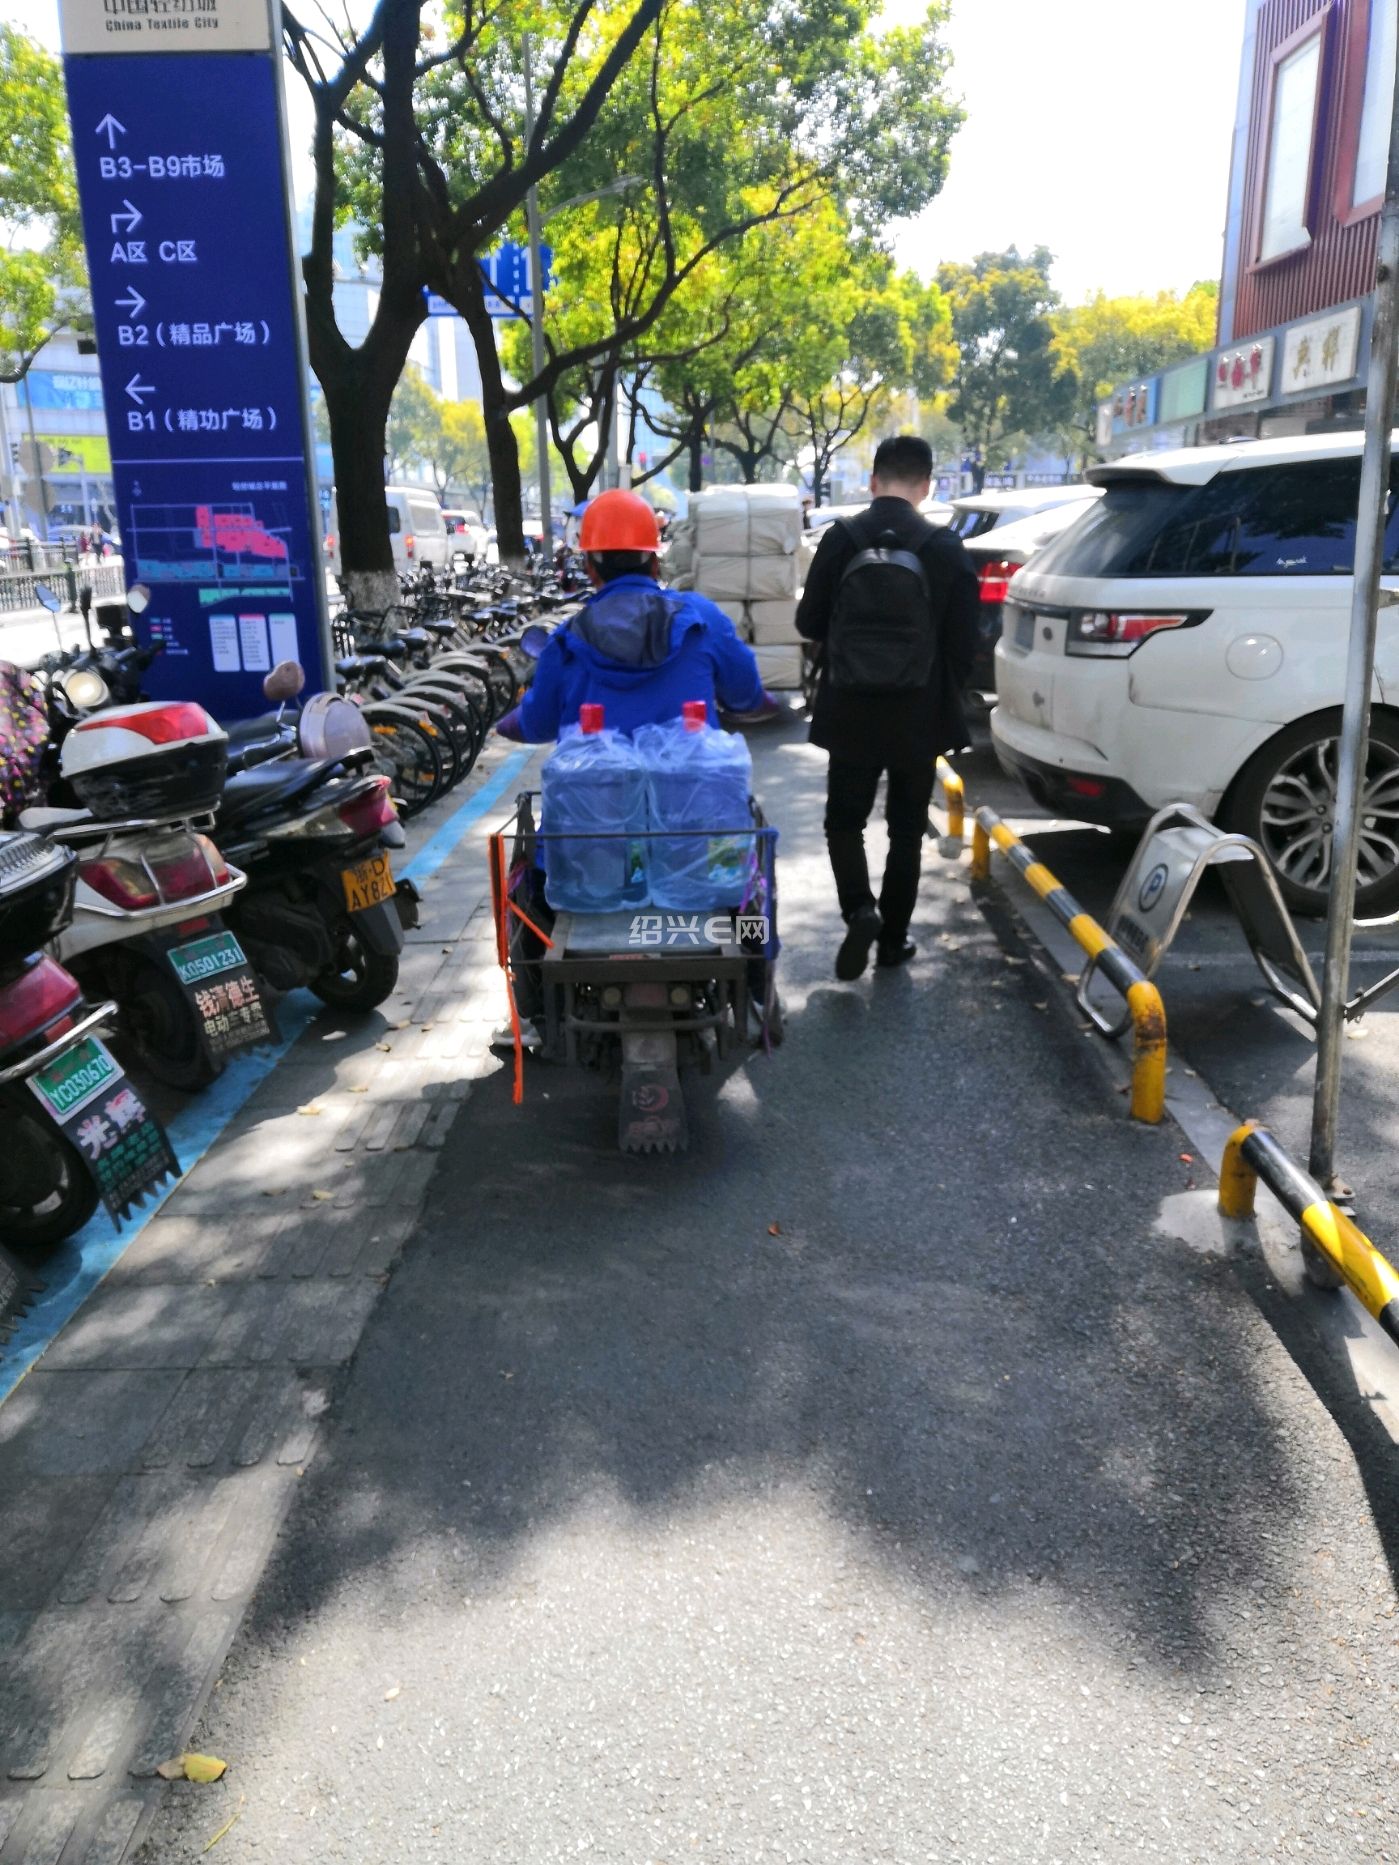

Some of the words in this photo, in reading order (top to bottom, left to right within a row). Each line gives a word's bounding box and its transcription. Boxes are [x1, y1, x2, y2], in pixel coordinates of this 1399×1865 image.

[105, 18, 142, 32] China
[146, 18, 189, 30] Textile
[195, 16, 219, 29] City
[99, 154, 226, 179] B3-B9市场
[110, 241, 148, 263] A区
[158, 240, 198, 262] C区
[117, 320, 271, 347] B2（精品广场）
